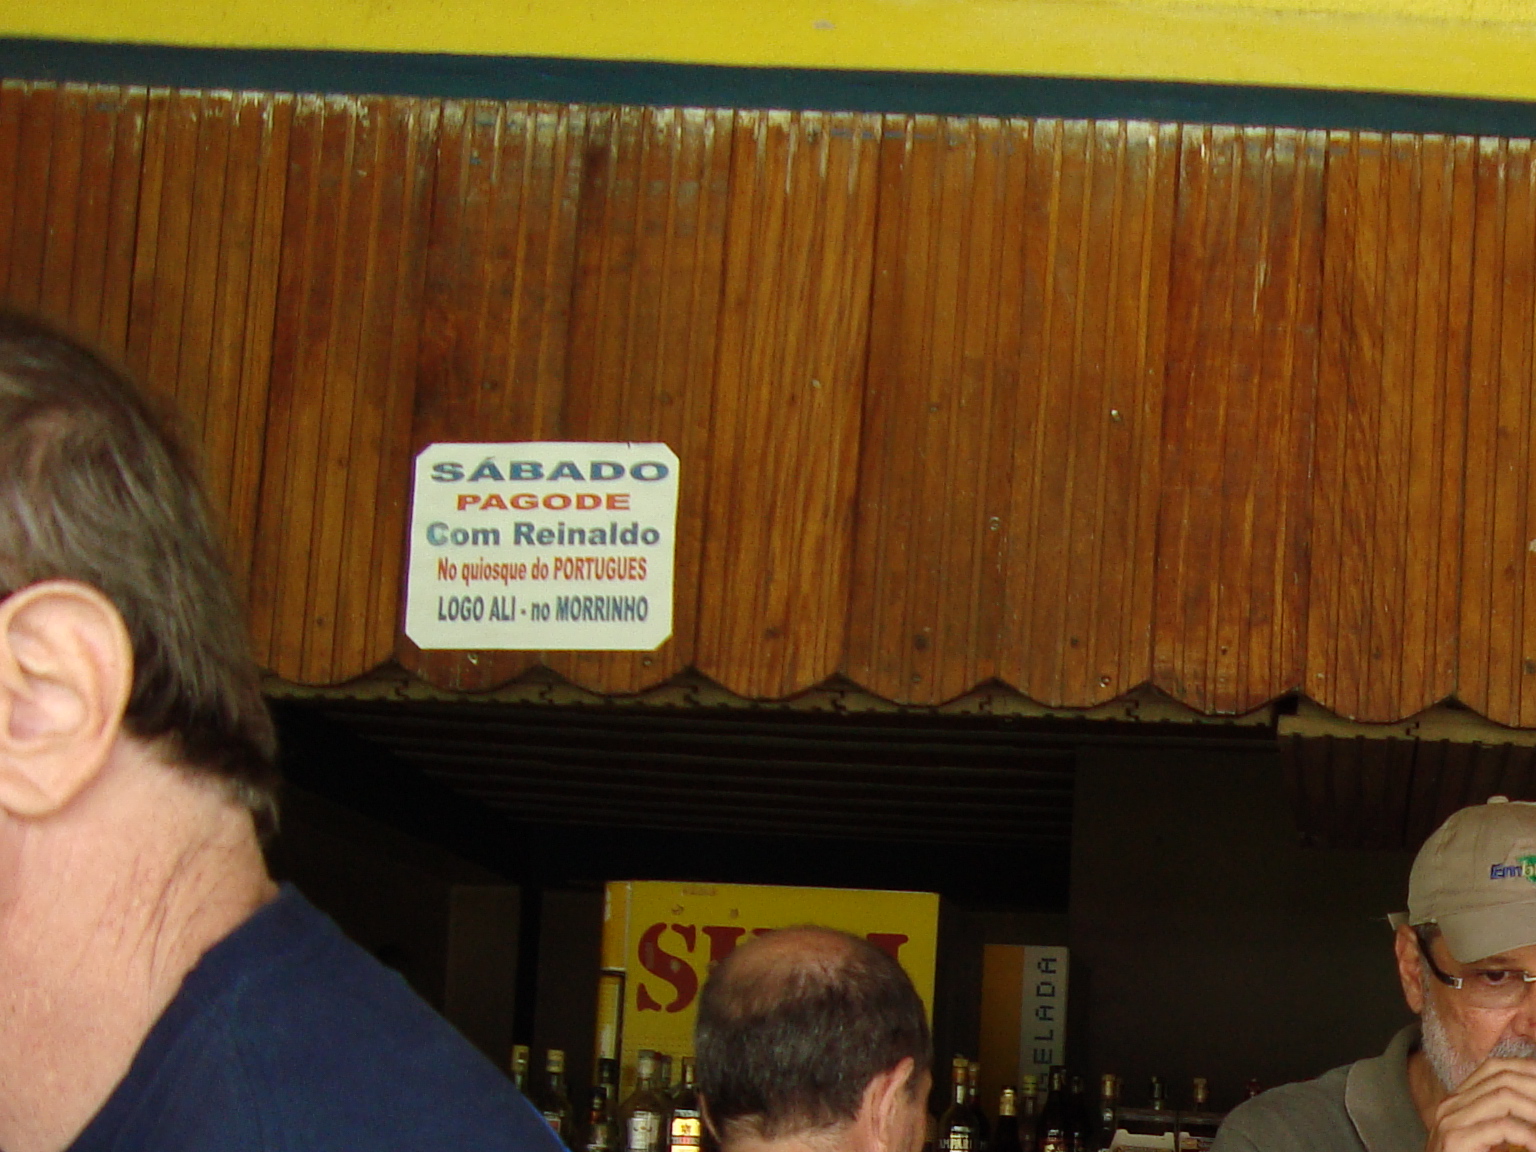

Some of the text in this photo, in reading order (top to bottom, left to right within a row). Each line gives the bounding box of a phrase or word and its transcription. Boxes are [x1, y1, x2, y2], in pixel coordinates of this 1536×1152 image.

[431, 457, 669, 482] SÁBADO
[456, 493, 631, 511] PAGODE
[426, 521, 660, 546] Com Reinaldo
[437, 556, 648, 586] No quiosque do PORTUGUES
[437, 596, 485, 622] LOGO
[489, 596, 516, 621] ALI
[531, 600, 550, 622] no
[555, 596, 649, 622] MORRINHO
